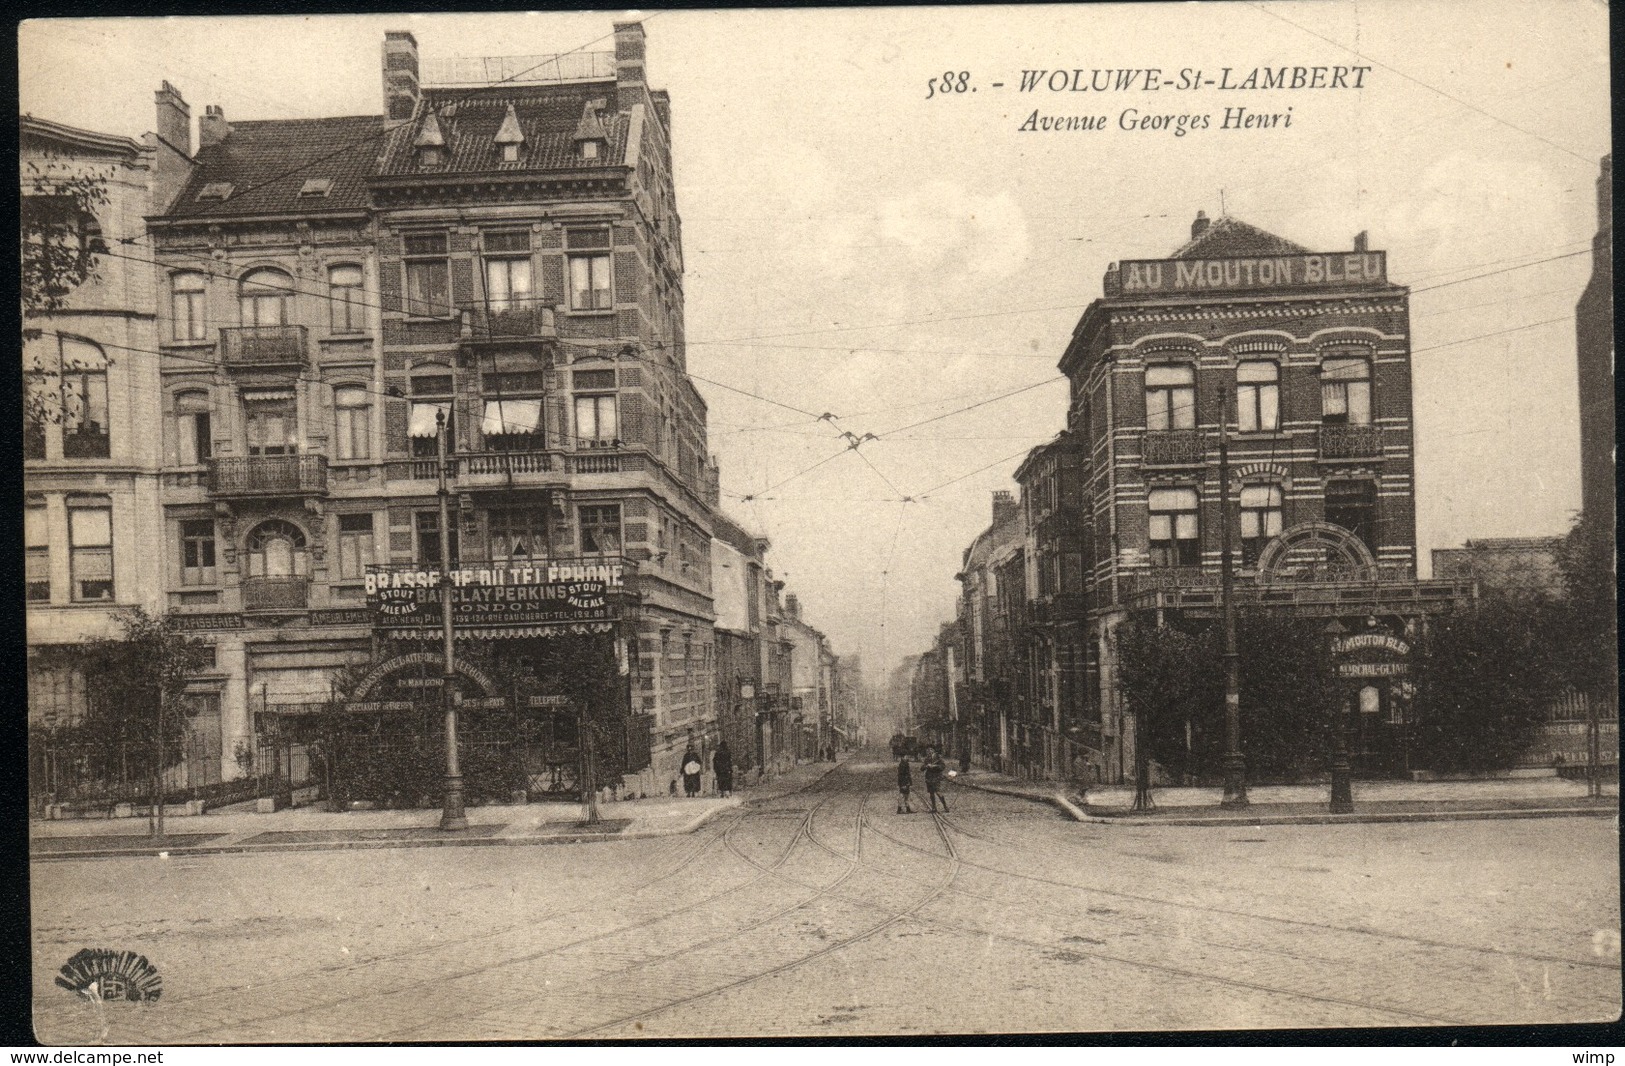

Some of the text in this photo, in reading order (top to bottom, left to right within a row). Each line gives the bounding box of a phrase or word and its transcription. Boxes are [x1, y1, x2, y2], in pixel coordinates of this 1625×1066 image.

[1123, 254, 1382, 290] AU MOUTON BLEU
[380, 588, 415, 601] STOUT
[495, 584, 567, 602] PERKINS
[568, 582, 603, 595] STOUT
[380, 601, 418, 615] PALE ALE
[567, 595, 606, 608] PALE ALE
[1346, 634, 1386, 650] MOUTON
[354, 657, 398, 697] BRASSERIE
